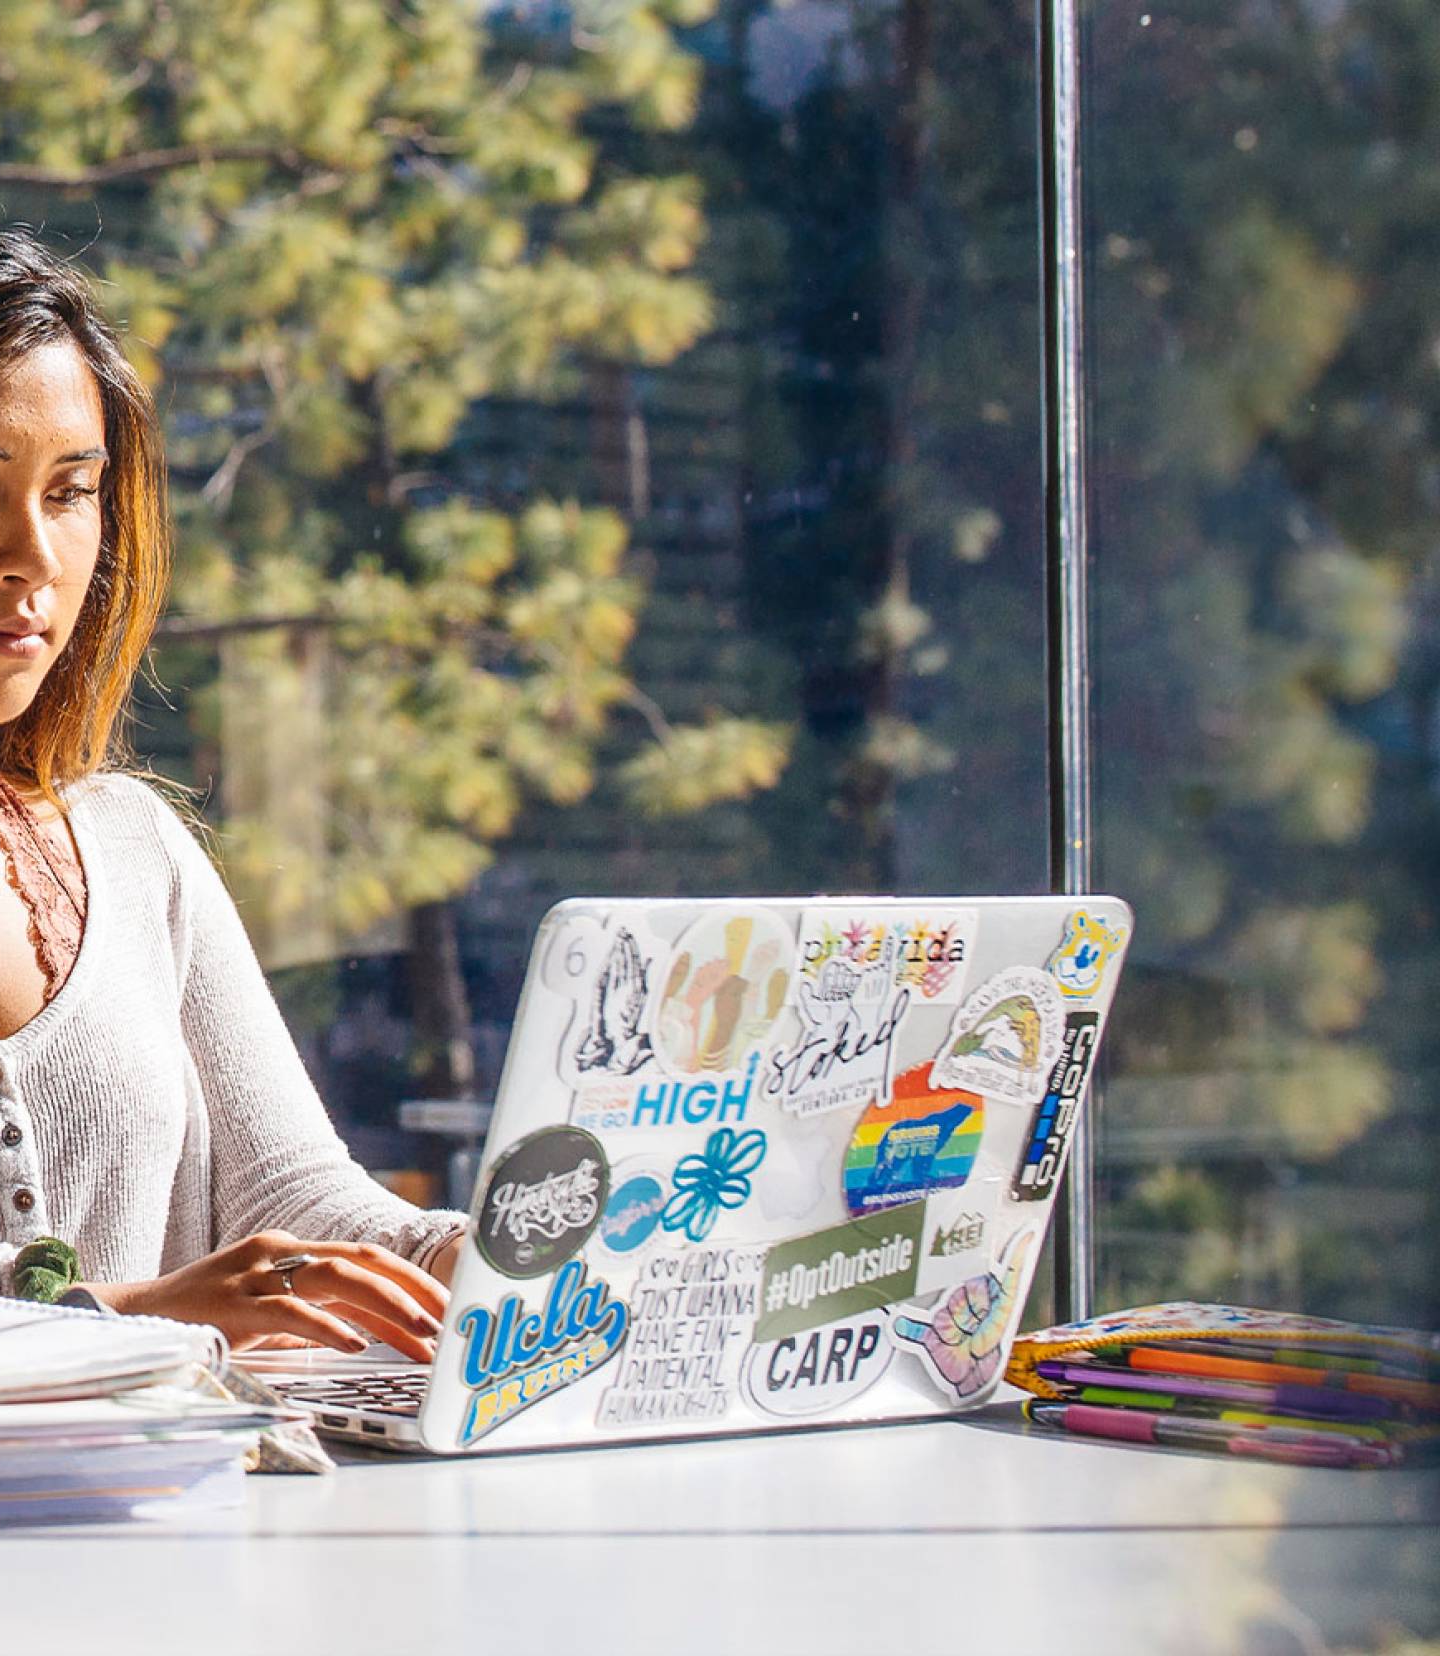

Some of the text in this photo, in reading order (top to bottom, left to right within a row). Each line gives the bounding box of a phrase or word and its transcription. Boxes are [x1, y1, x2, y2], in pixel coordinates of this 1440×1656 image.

[631, 1079, 753, 1127] HIGH
[1036, 1024, 1096, 1187] GoPro
[680, 1250, 733, 1283] GIRLS
[765, 1233, 913, 1313] #OptOutside
[632, 1284, 755, 1321] JUST WANNA
[632, 1321, 687, 1354] HAVE
[766, 1324, 882, 1392] CARP
[471, 1338, 609, 1434] BRUINS
[602, 1393, 667, 1424] HUMAN
